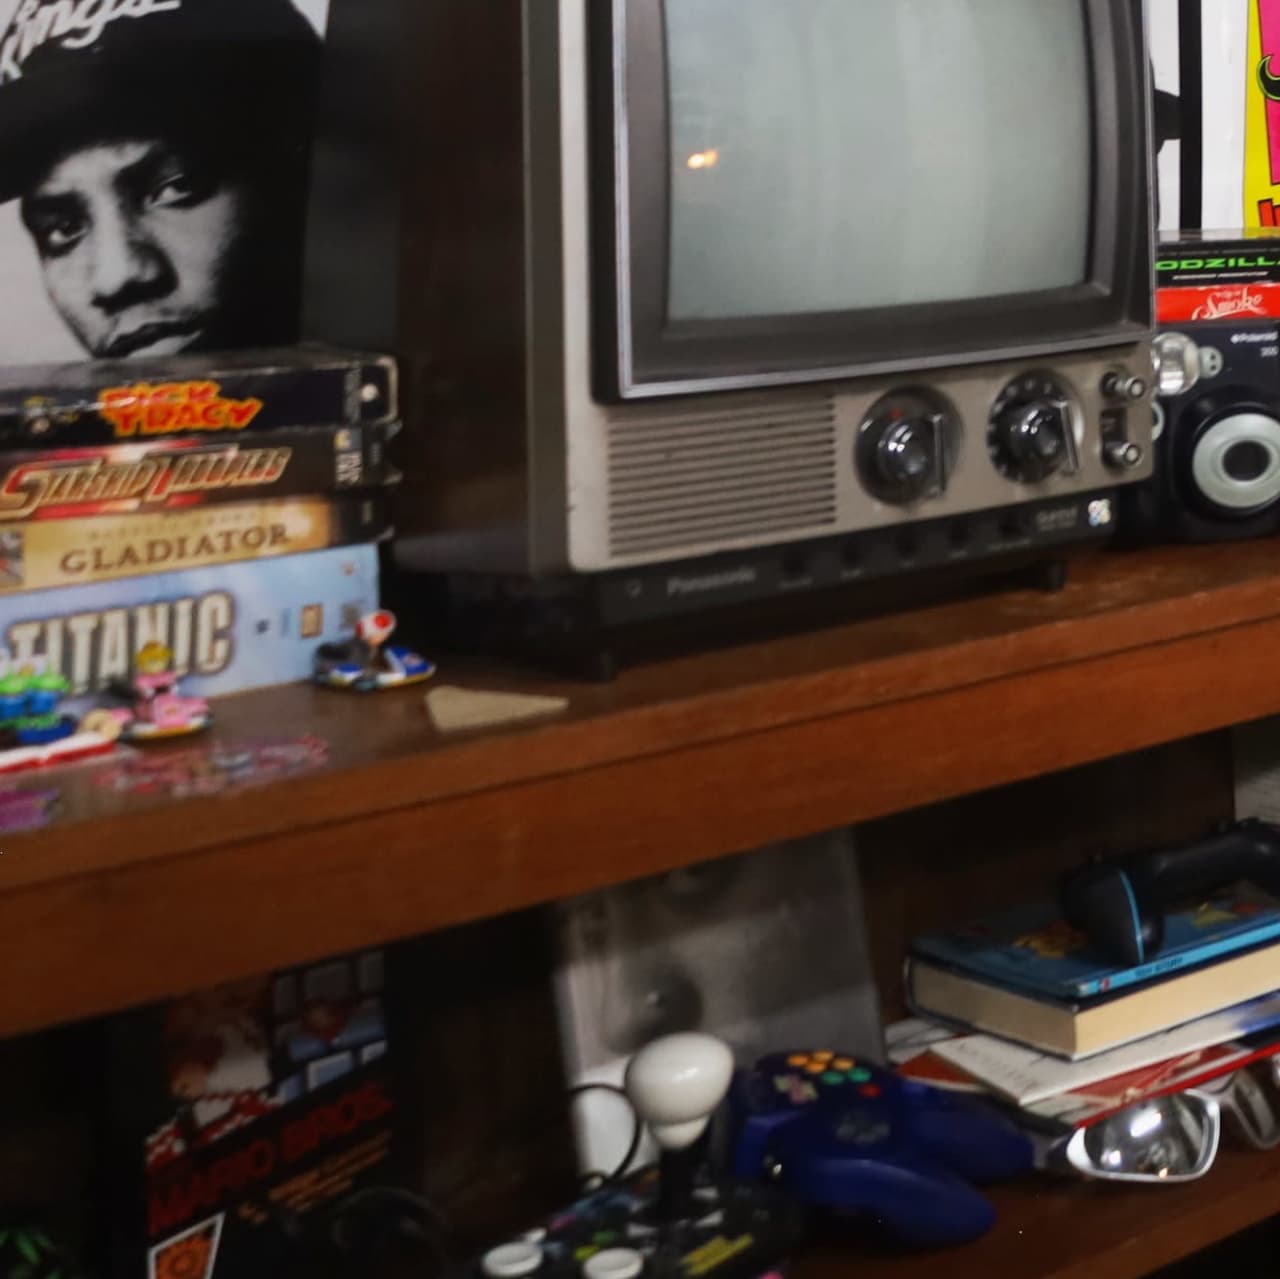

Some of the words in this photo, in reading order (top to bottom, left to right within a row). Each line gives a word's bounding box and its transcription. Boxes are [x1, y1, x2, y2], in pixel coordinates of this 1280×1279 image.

[1192, 287, 1267, 320] Smoke
[1237, 331, 1279, 345] Polaroid
[100, 380, 222, 410] DICK
[102, 397, 264, 436] TRACY
[142, 447, 292, 502] TROOPERS
[58, 524, 292, 574] GLADIATOR
[666, 565, 757, 596] Panasonic
[8, 590, 235, 696] TITANIC
